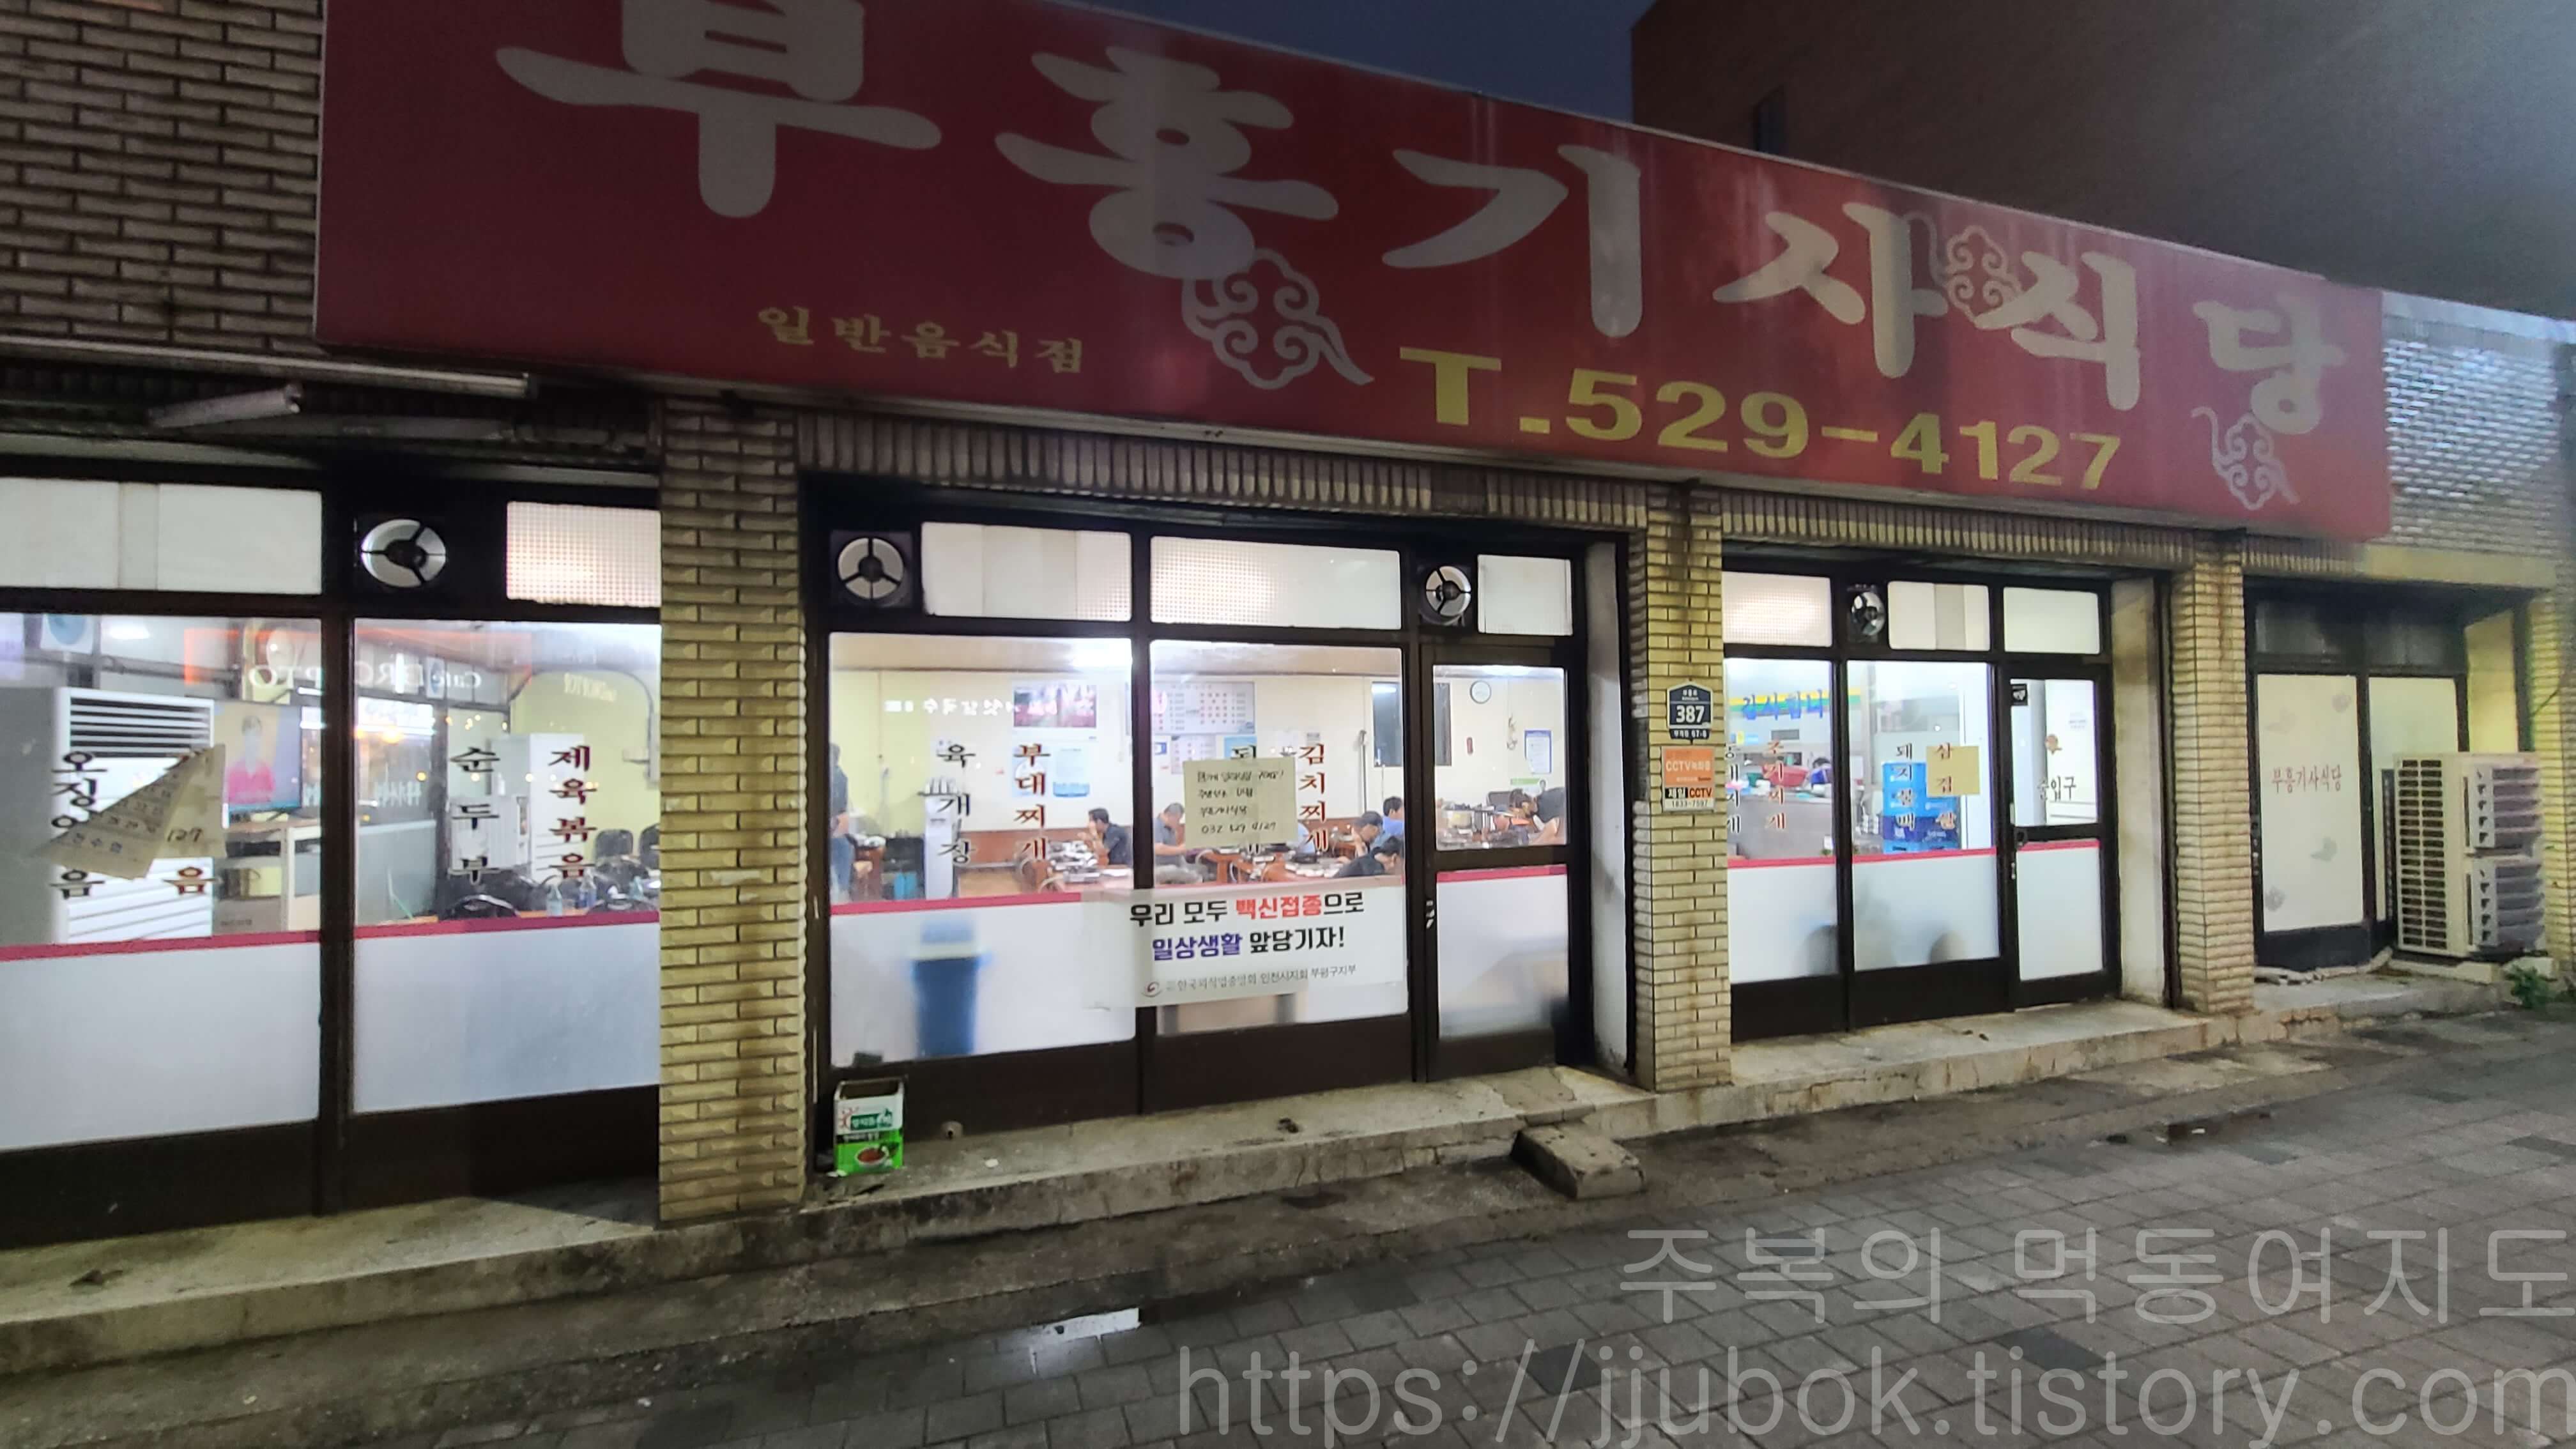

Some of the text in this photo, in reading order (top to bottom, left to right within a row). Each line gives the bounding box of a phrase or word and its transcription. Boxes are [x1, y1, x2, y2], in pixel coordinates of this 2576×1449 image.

[758, 306, 1082, 374] 일반음식점
[1399, 347, 2121, 491] T.529-4127
[1676, 705, 1705, 723] 387
[50, 750, 107, 899] 오징어음
[450, 747, 501, 885] 순두부
[548, 746, 597, 878] 제육볶음
[937, 744, 976, 863] 육개장
[1014, 743, 1050, 860] 부대찌개
[1299, 743, 1328, 852] 김치찌개
[1689, 787, 1712, 798] CCTV
[2271, 764, 2343, 793] 부흥기사식당
[1130, 892, 1365, 927] 우리 모두 백신접종으로
[1153, 926, 1345, 962] 일상생활 앞당기자!
